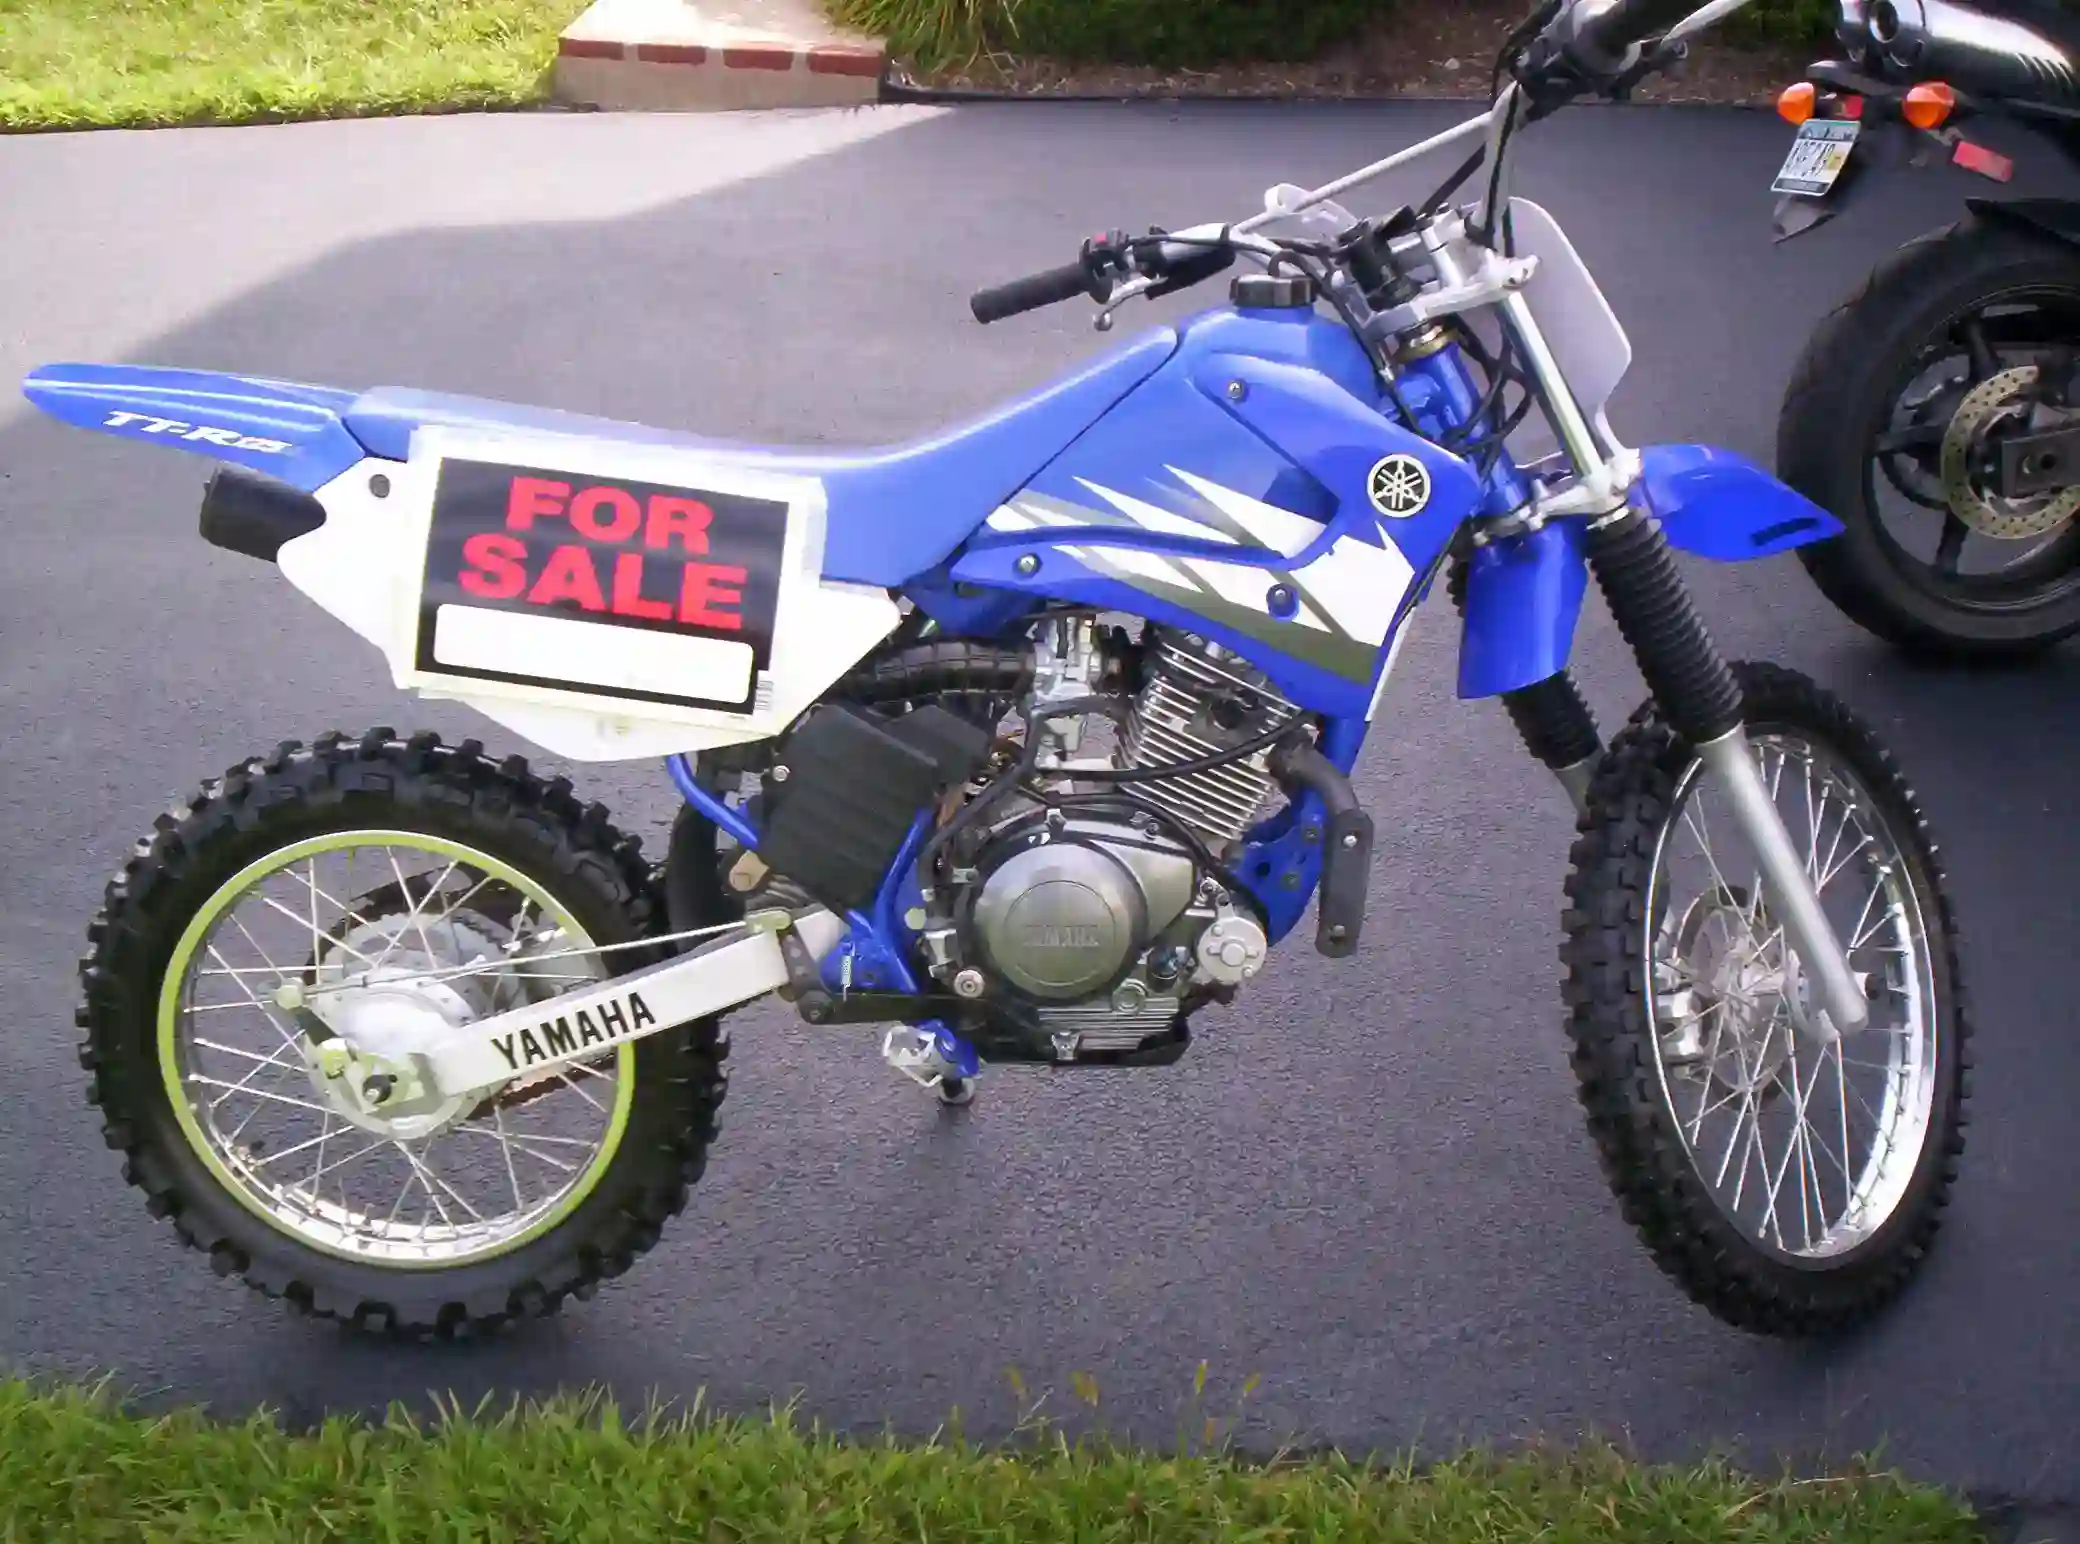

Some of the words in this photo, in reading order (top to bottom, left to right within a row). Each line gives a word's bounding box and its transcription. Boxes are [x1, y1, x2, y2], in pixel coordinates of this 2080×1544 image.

[505, 475, 715, 555] FOR
[457, 532, 748, 630] SALE
[1021, 925, 1100, 948] MAHA
[490, 991, 657, 1070] YAMAHA
